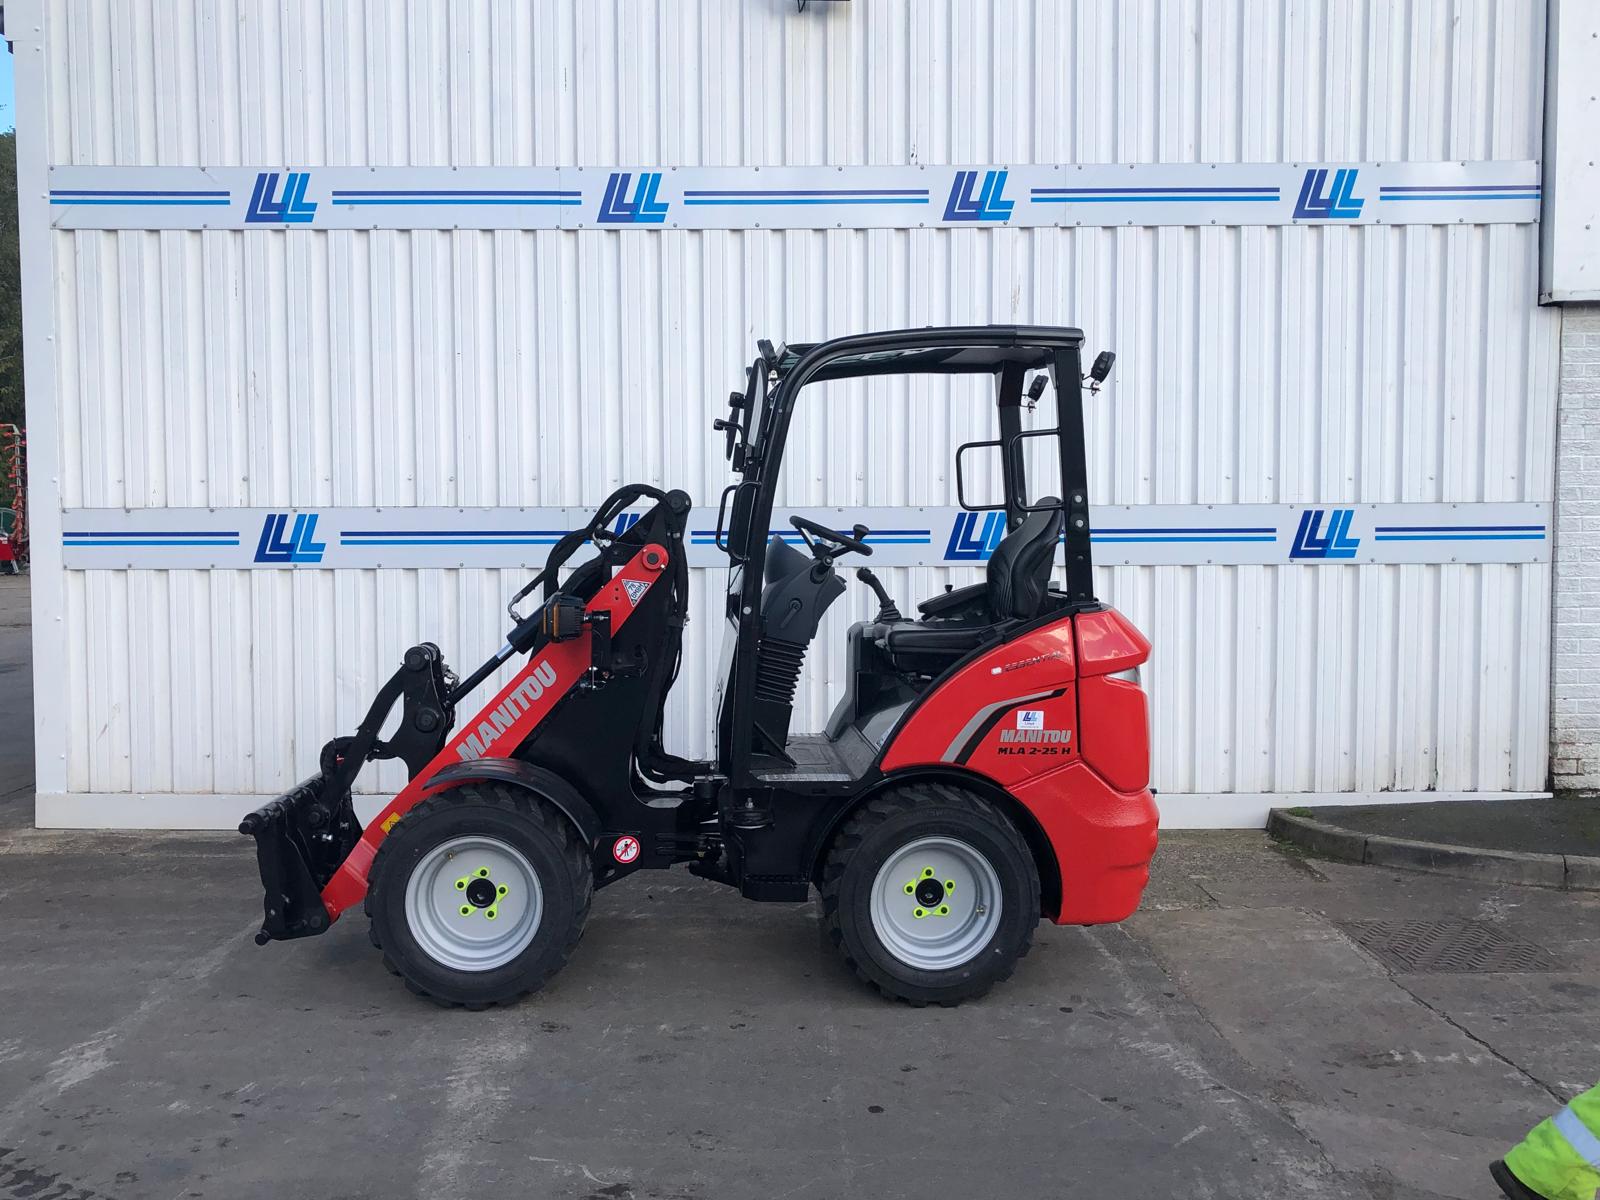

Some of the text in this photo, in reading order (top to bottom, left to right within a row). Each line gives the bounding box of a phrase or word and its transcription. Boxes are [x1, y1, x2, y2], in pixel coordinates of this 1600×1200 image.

[456, 660, 557, 761] MANITOU
[1000, 729, 1072, 743] MANITOU
[998, 747, 1071, 755] MLA 2-25 H
